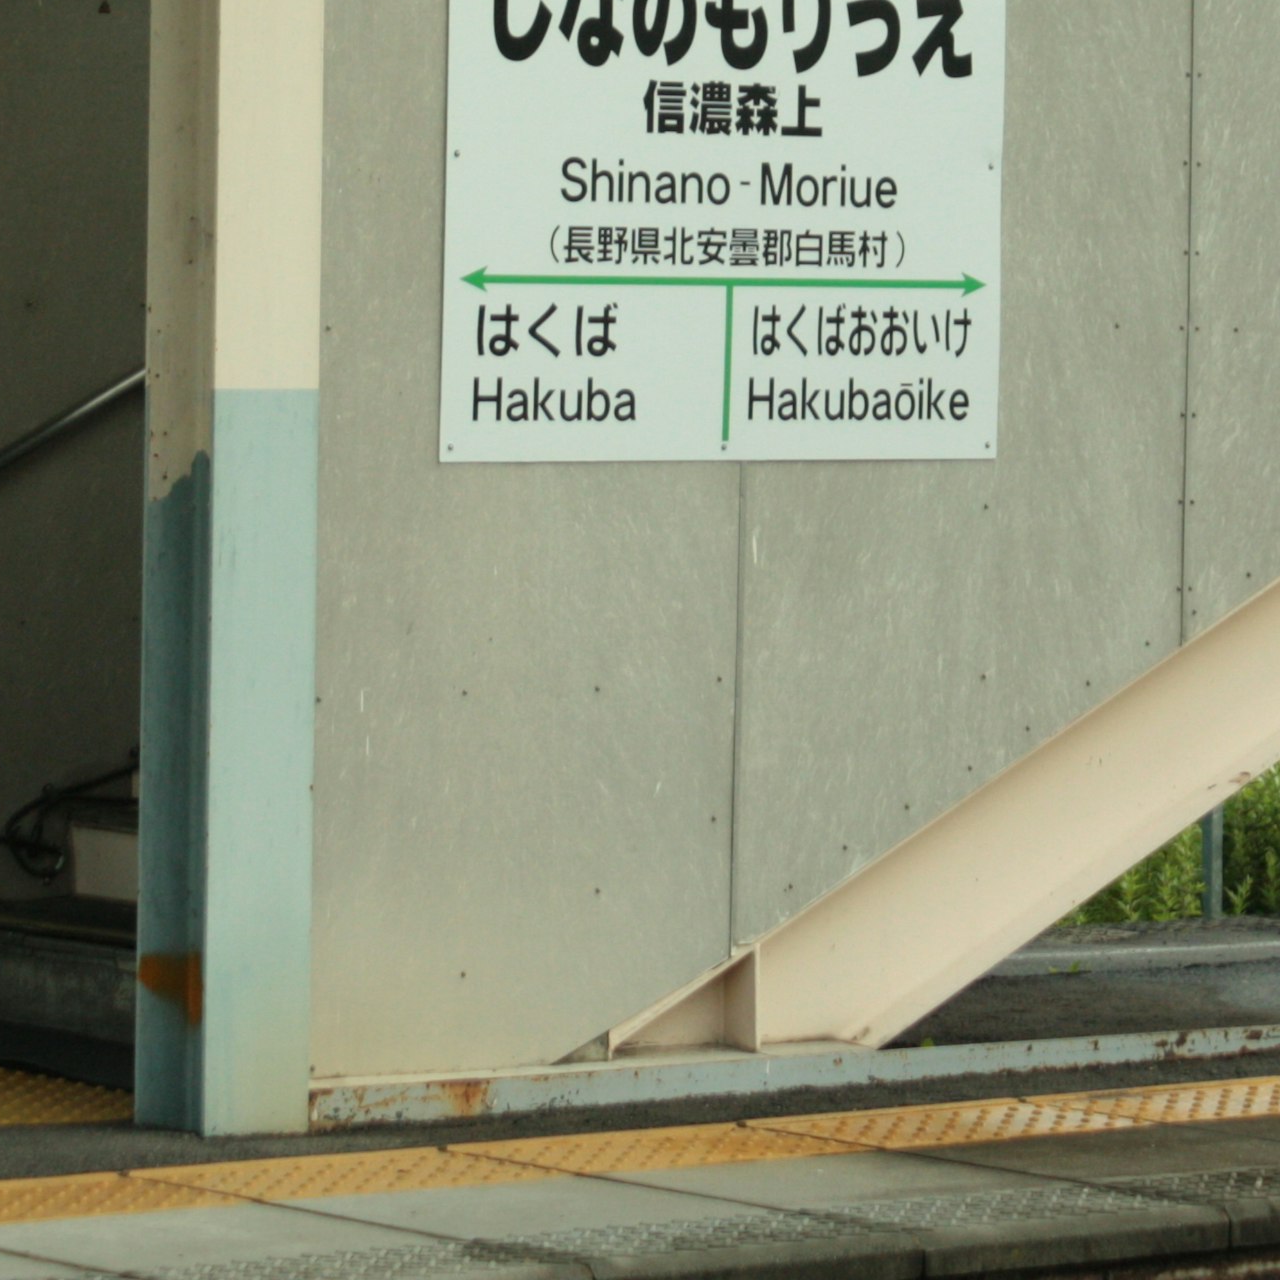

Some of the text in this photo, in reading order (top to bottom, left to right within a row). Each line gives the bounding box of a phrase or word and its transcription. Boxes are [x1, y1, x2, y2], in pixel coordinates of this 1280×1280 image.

[642, 79, 823, 138] 信濃森上
[476, 302, 619, 359] はくば
[752, 303, 973, 359] はくばおおいけ
[471, 376, 637, 423] Hakuba
[747, 376, 970, 422] Hakubaōike
